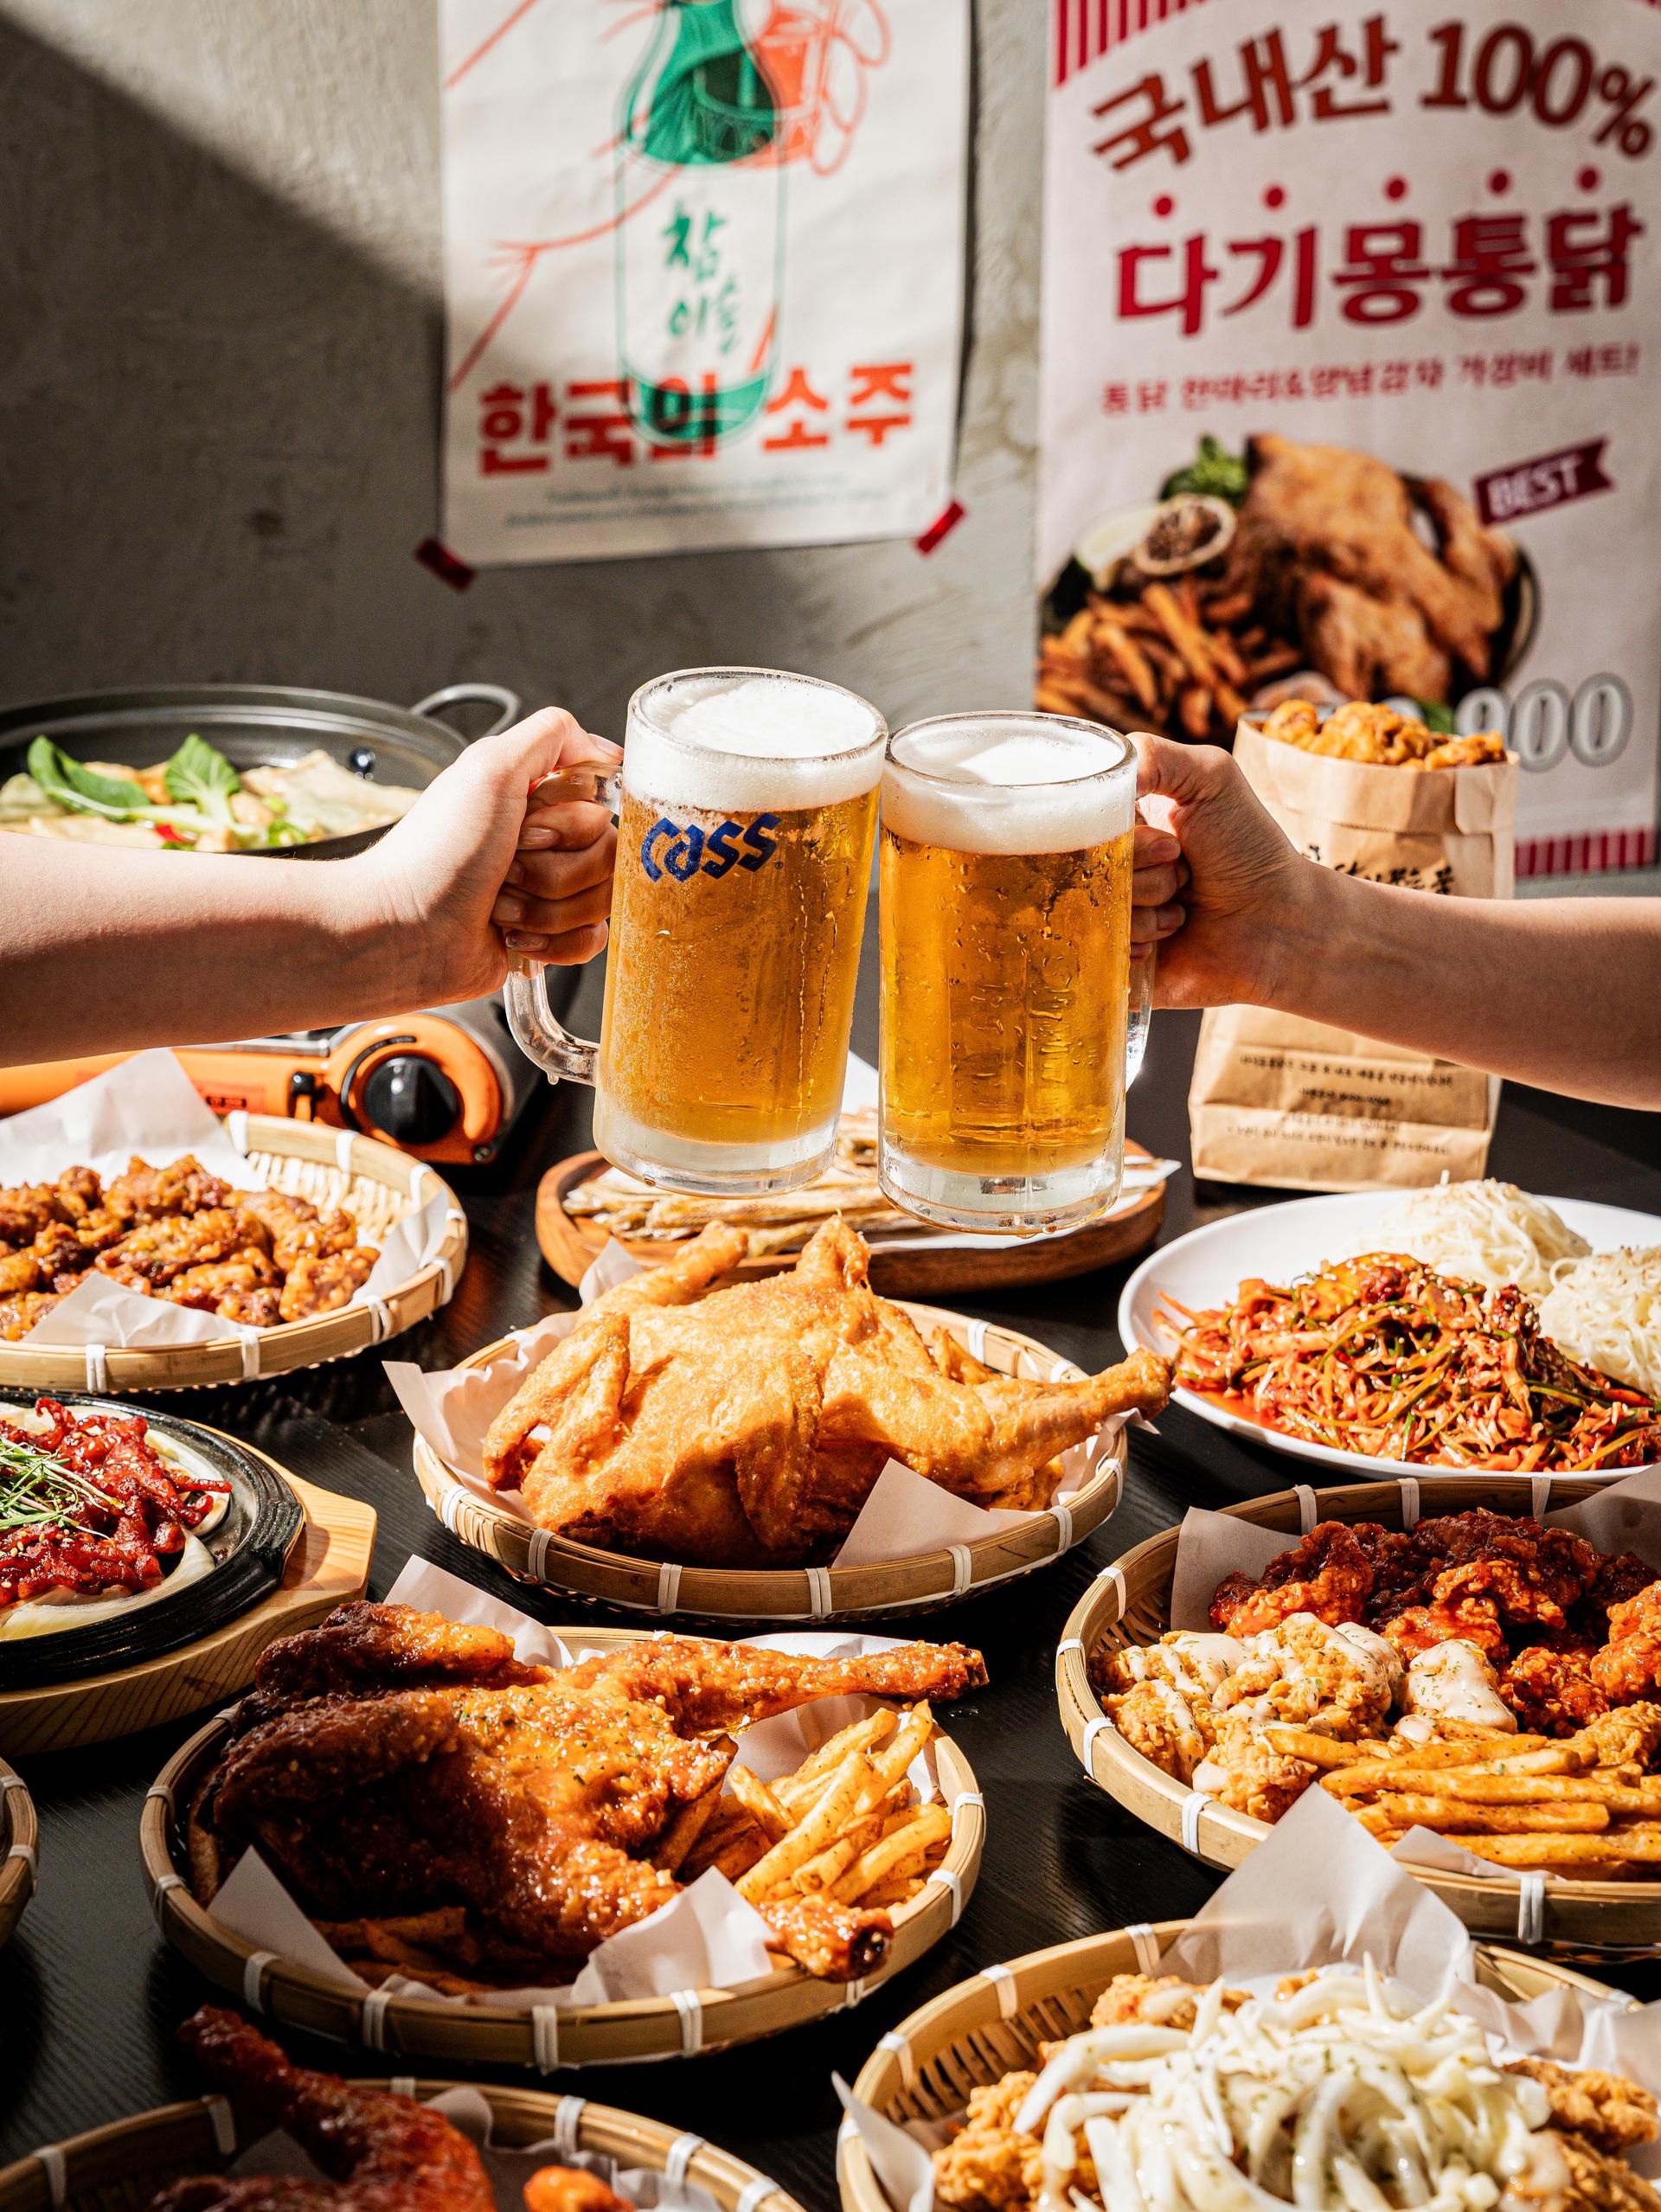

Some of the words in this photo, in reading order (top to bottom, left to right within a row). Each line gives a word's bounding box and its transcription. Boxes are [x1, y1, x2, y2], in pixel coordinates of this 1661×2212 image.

[1092, 15, 1400, 171] 국내산
[1421, 21, 1654, 159] 100%
[1116, 202, 1644, 337] 다기몽통닭
[478, 370, 719, 479] 한국의
[760, 361, 915, 452] 소주
[1486, 453, 1585, 519] BEST
